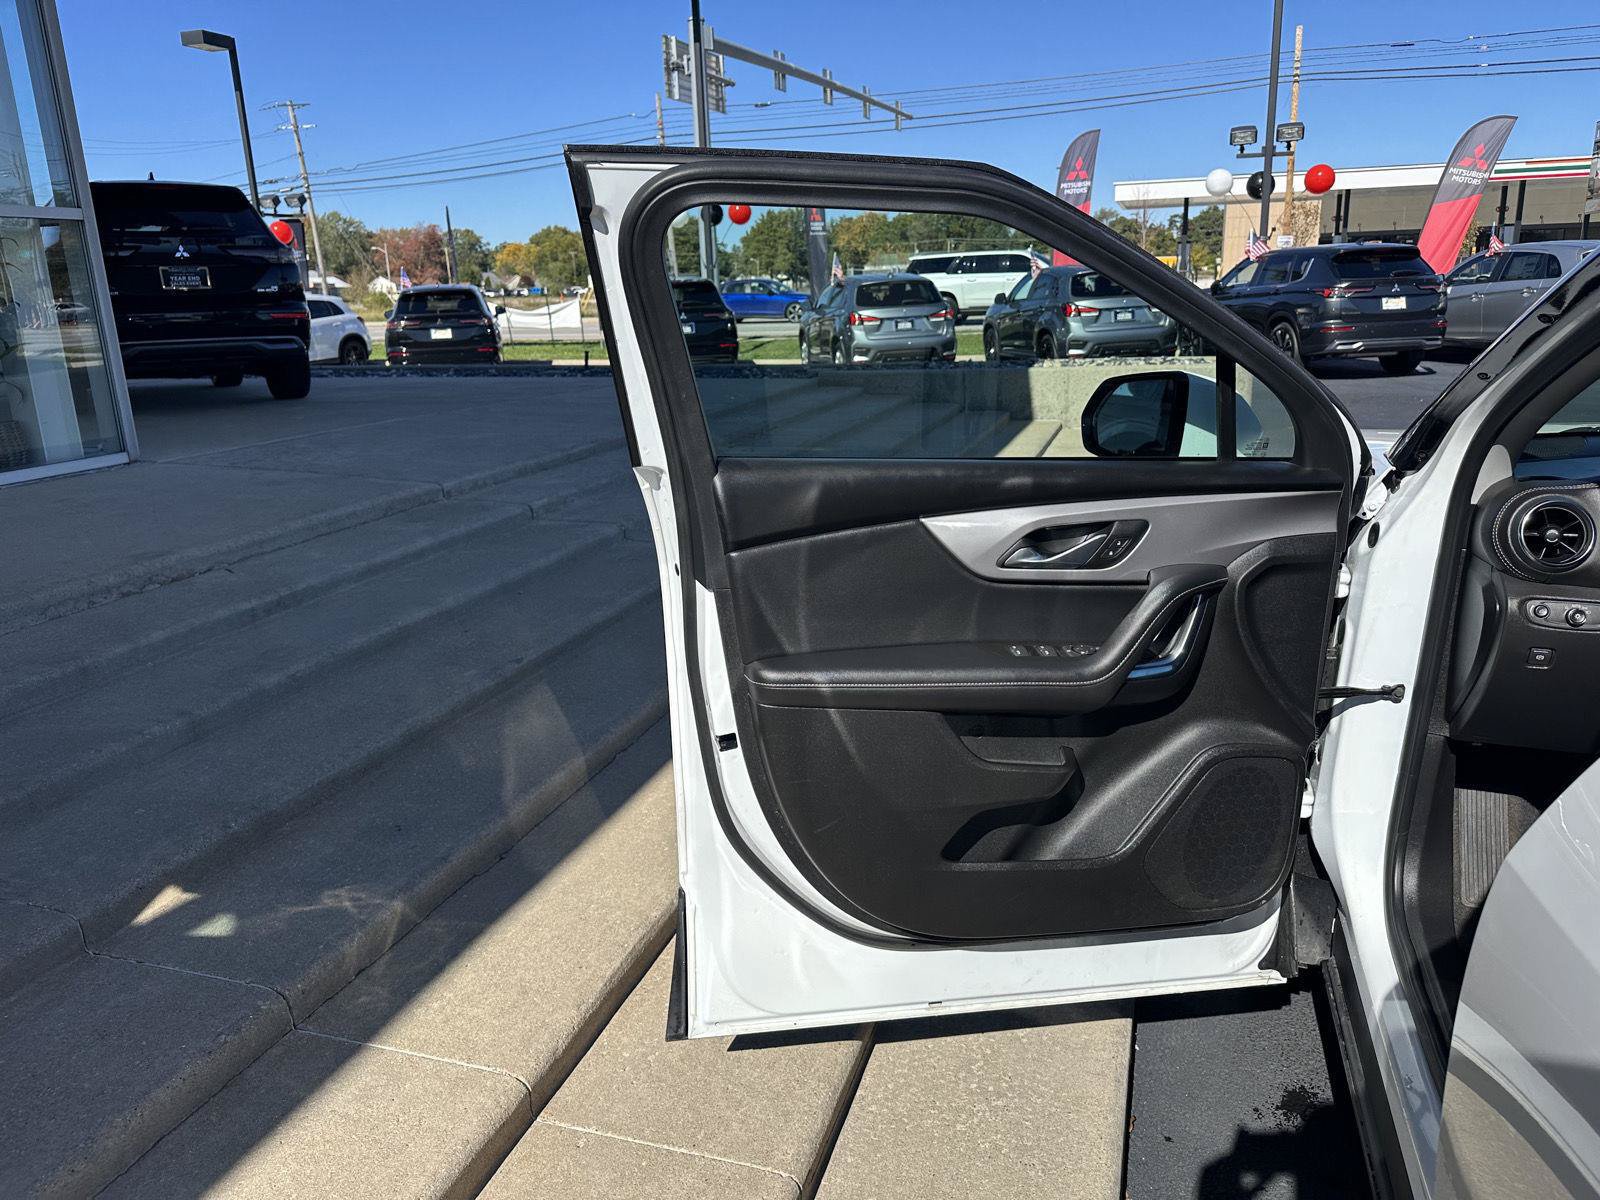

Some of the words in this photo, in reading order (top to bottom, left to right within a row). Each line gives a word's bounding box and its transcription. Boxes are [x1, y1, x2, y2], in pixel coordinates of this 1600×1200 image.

[1449, 167, 1489, 179] MITSUBISHI
[1452, 175, 1482, 185] MOTORS
[1064, 187, 1088, 195] MOTORS
